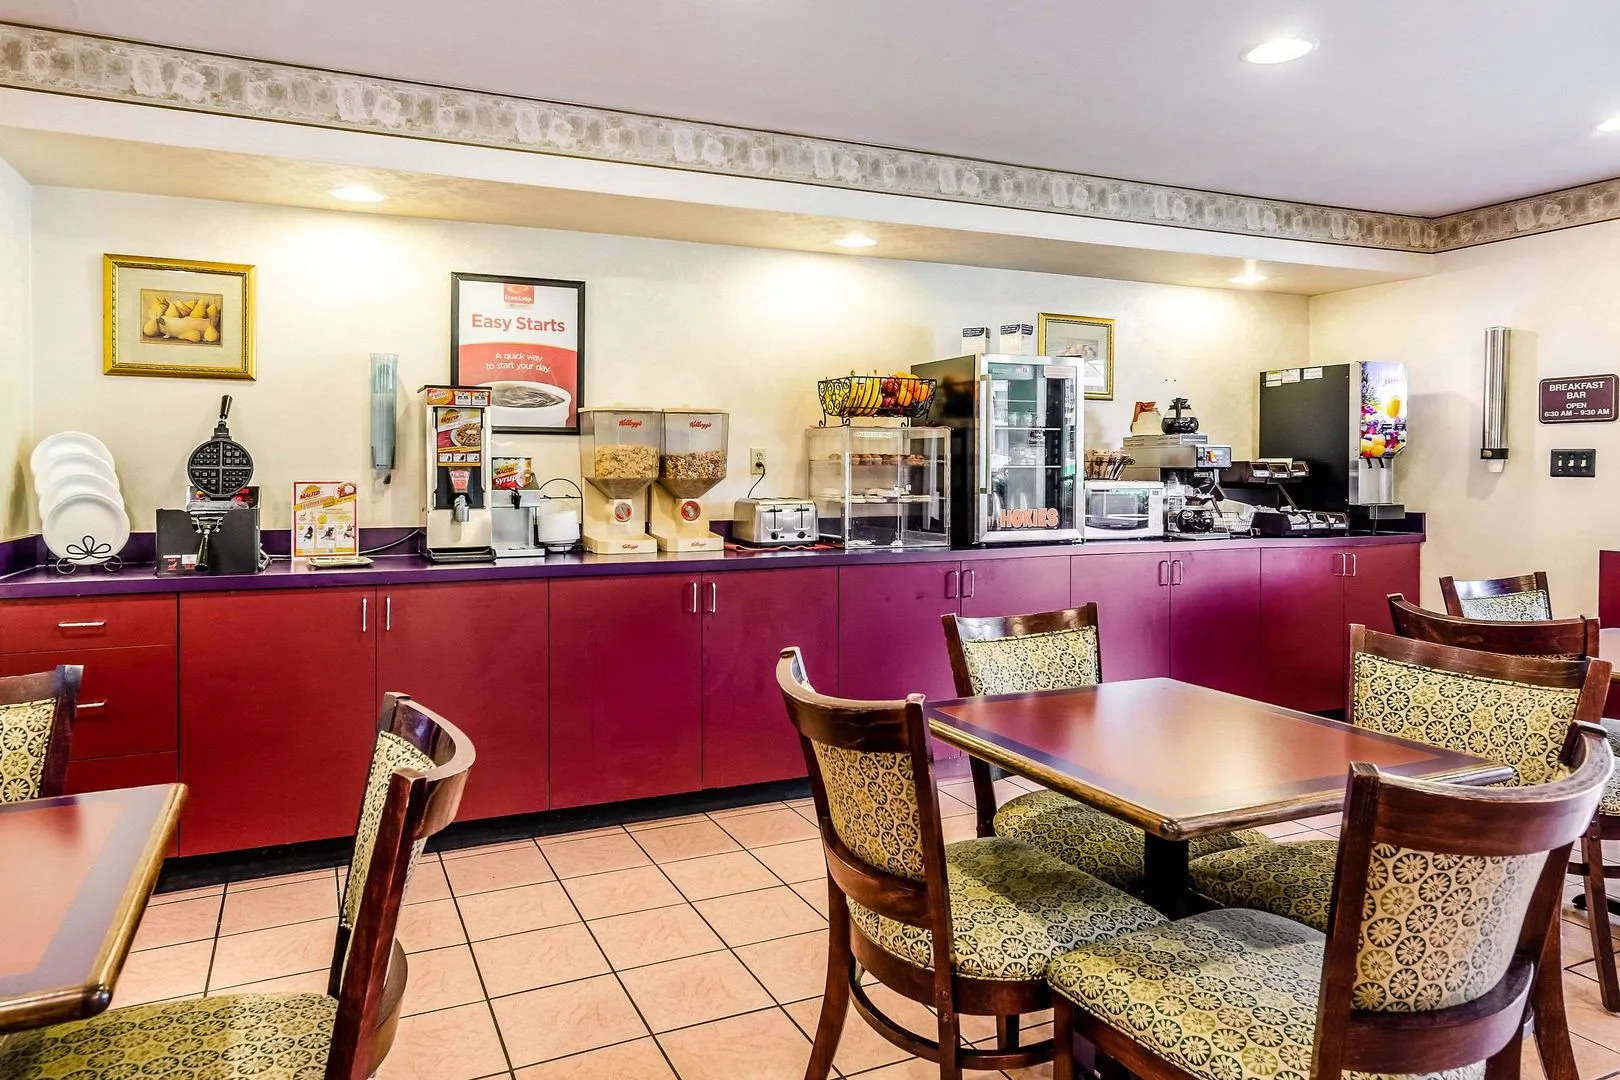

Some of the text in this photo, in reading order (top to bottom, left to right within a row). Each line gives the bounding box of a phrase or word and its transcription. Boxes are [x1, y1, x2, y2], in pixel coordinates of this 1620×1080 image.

[472, 314, 565, 332] Easy Starts
[495, 352, 543, 362] A quick way
[496, 361, 515, 369] start
[516, 363, 534, 372] your
[1549, 381, 1605, 392] BREAKFAST
[1566, 391, 1586, 399] BAR
[1544, 410, 1560, 418] 6:30
[1000, 508, 1059, 528] HOKIES
